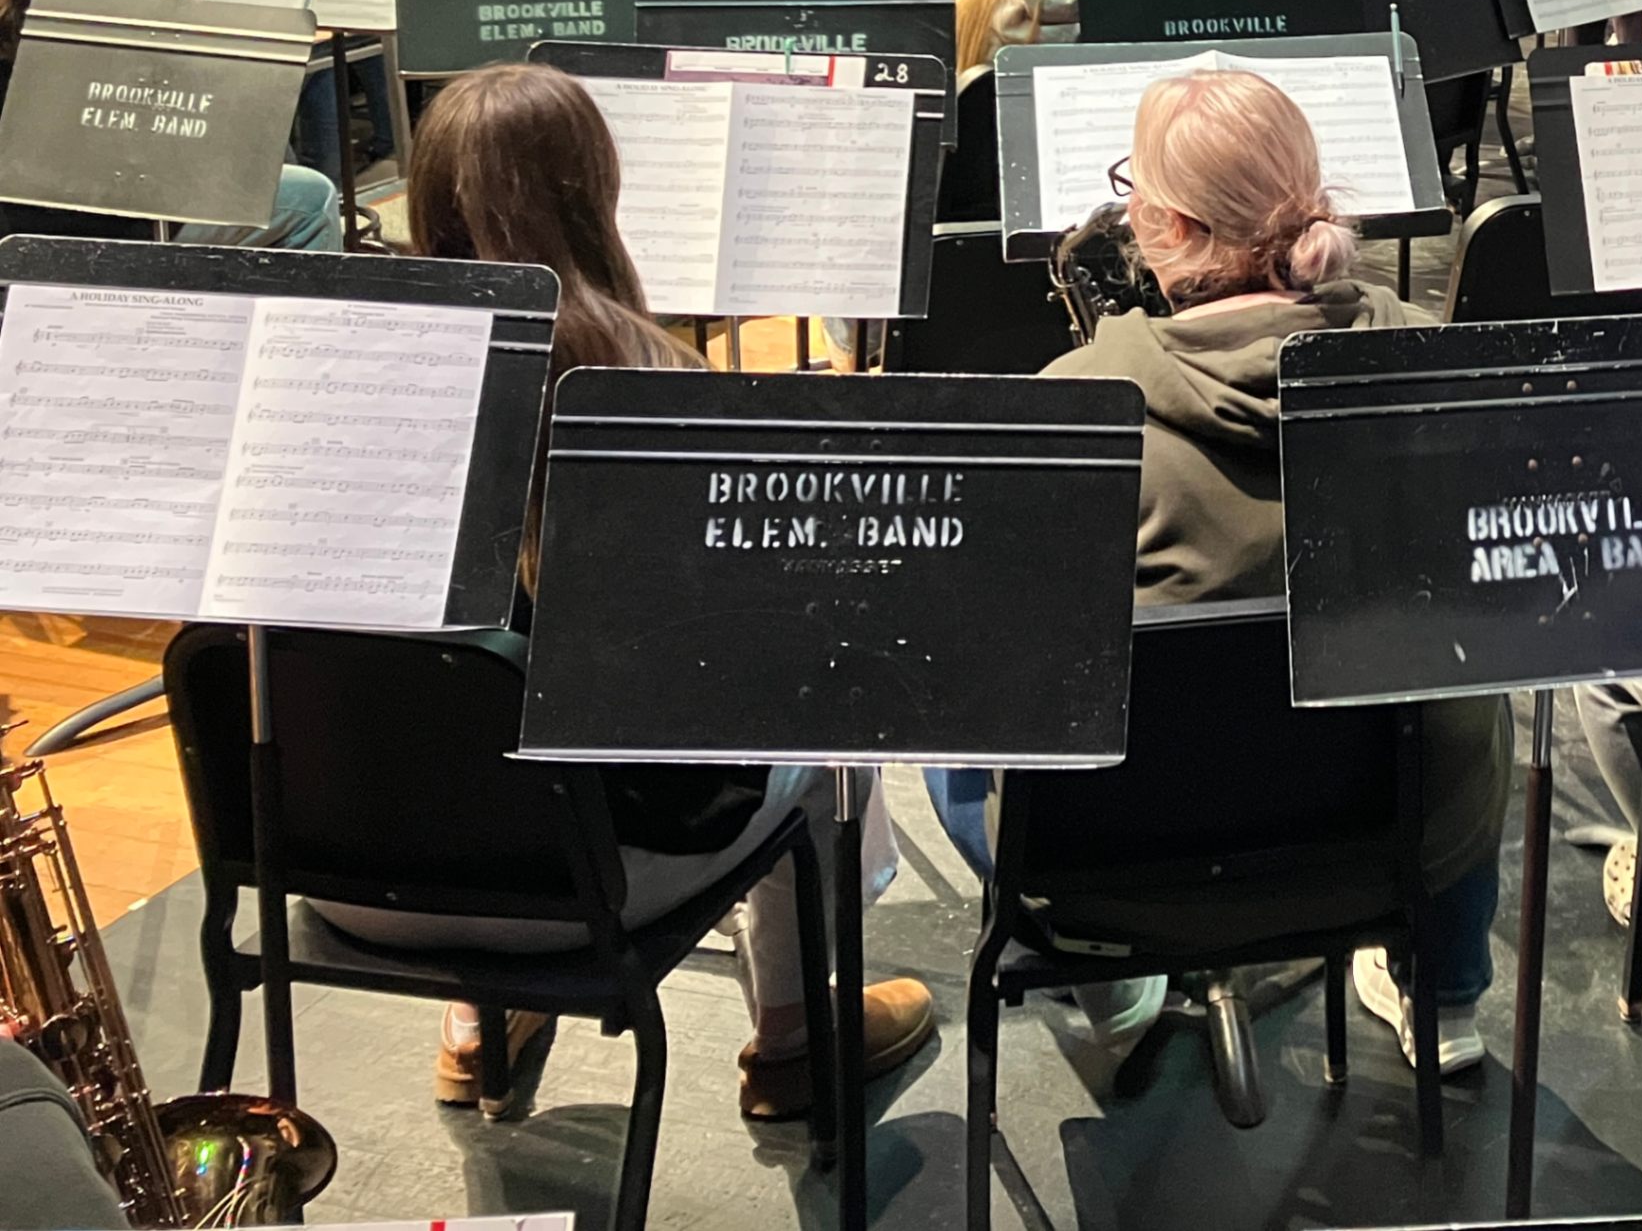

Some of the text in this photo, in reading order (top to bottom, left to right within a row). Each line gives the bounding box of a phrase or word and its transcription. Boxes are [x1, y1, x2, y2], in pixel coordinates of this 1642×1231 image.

[478, 0, 604, 21] BROOKVILLE
[553, 20, 606, 37] BAND
[1164, 14, 1287, 36] BROOKVILLE
[874, 62, 909, 83] 28
[88, 81, 214, 114] BROOKVILLE
[151, 115, 207, 138] BAND
[708, 472, 963, 504] BROOKVILLE
[705, 515, 963, 549] ELEM. BAND
[1471, 541, 1560, 583] AREA
